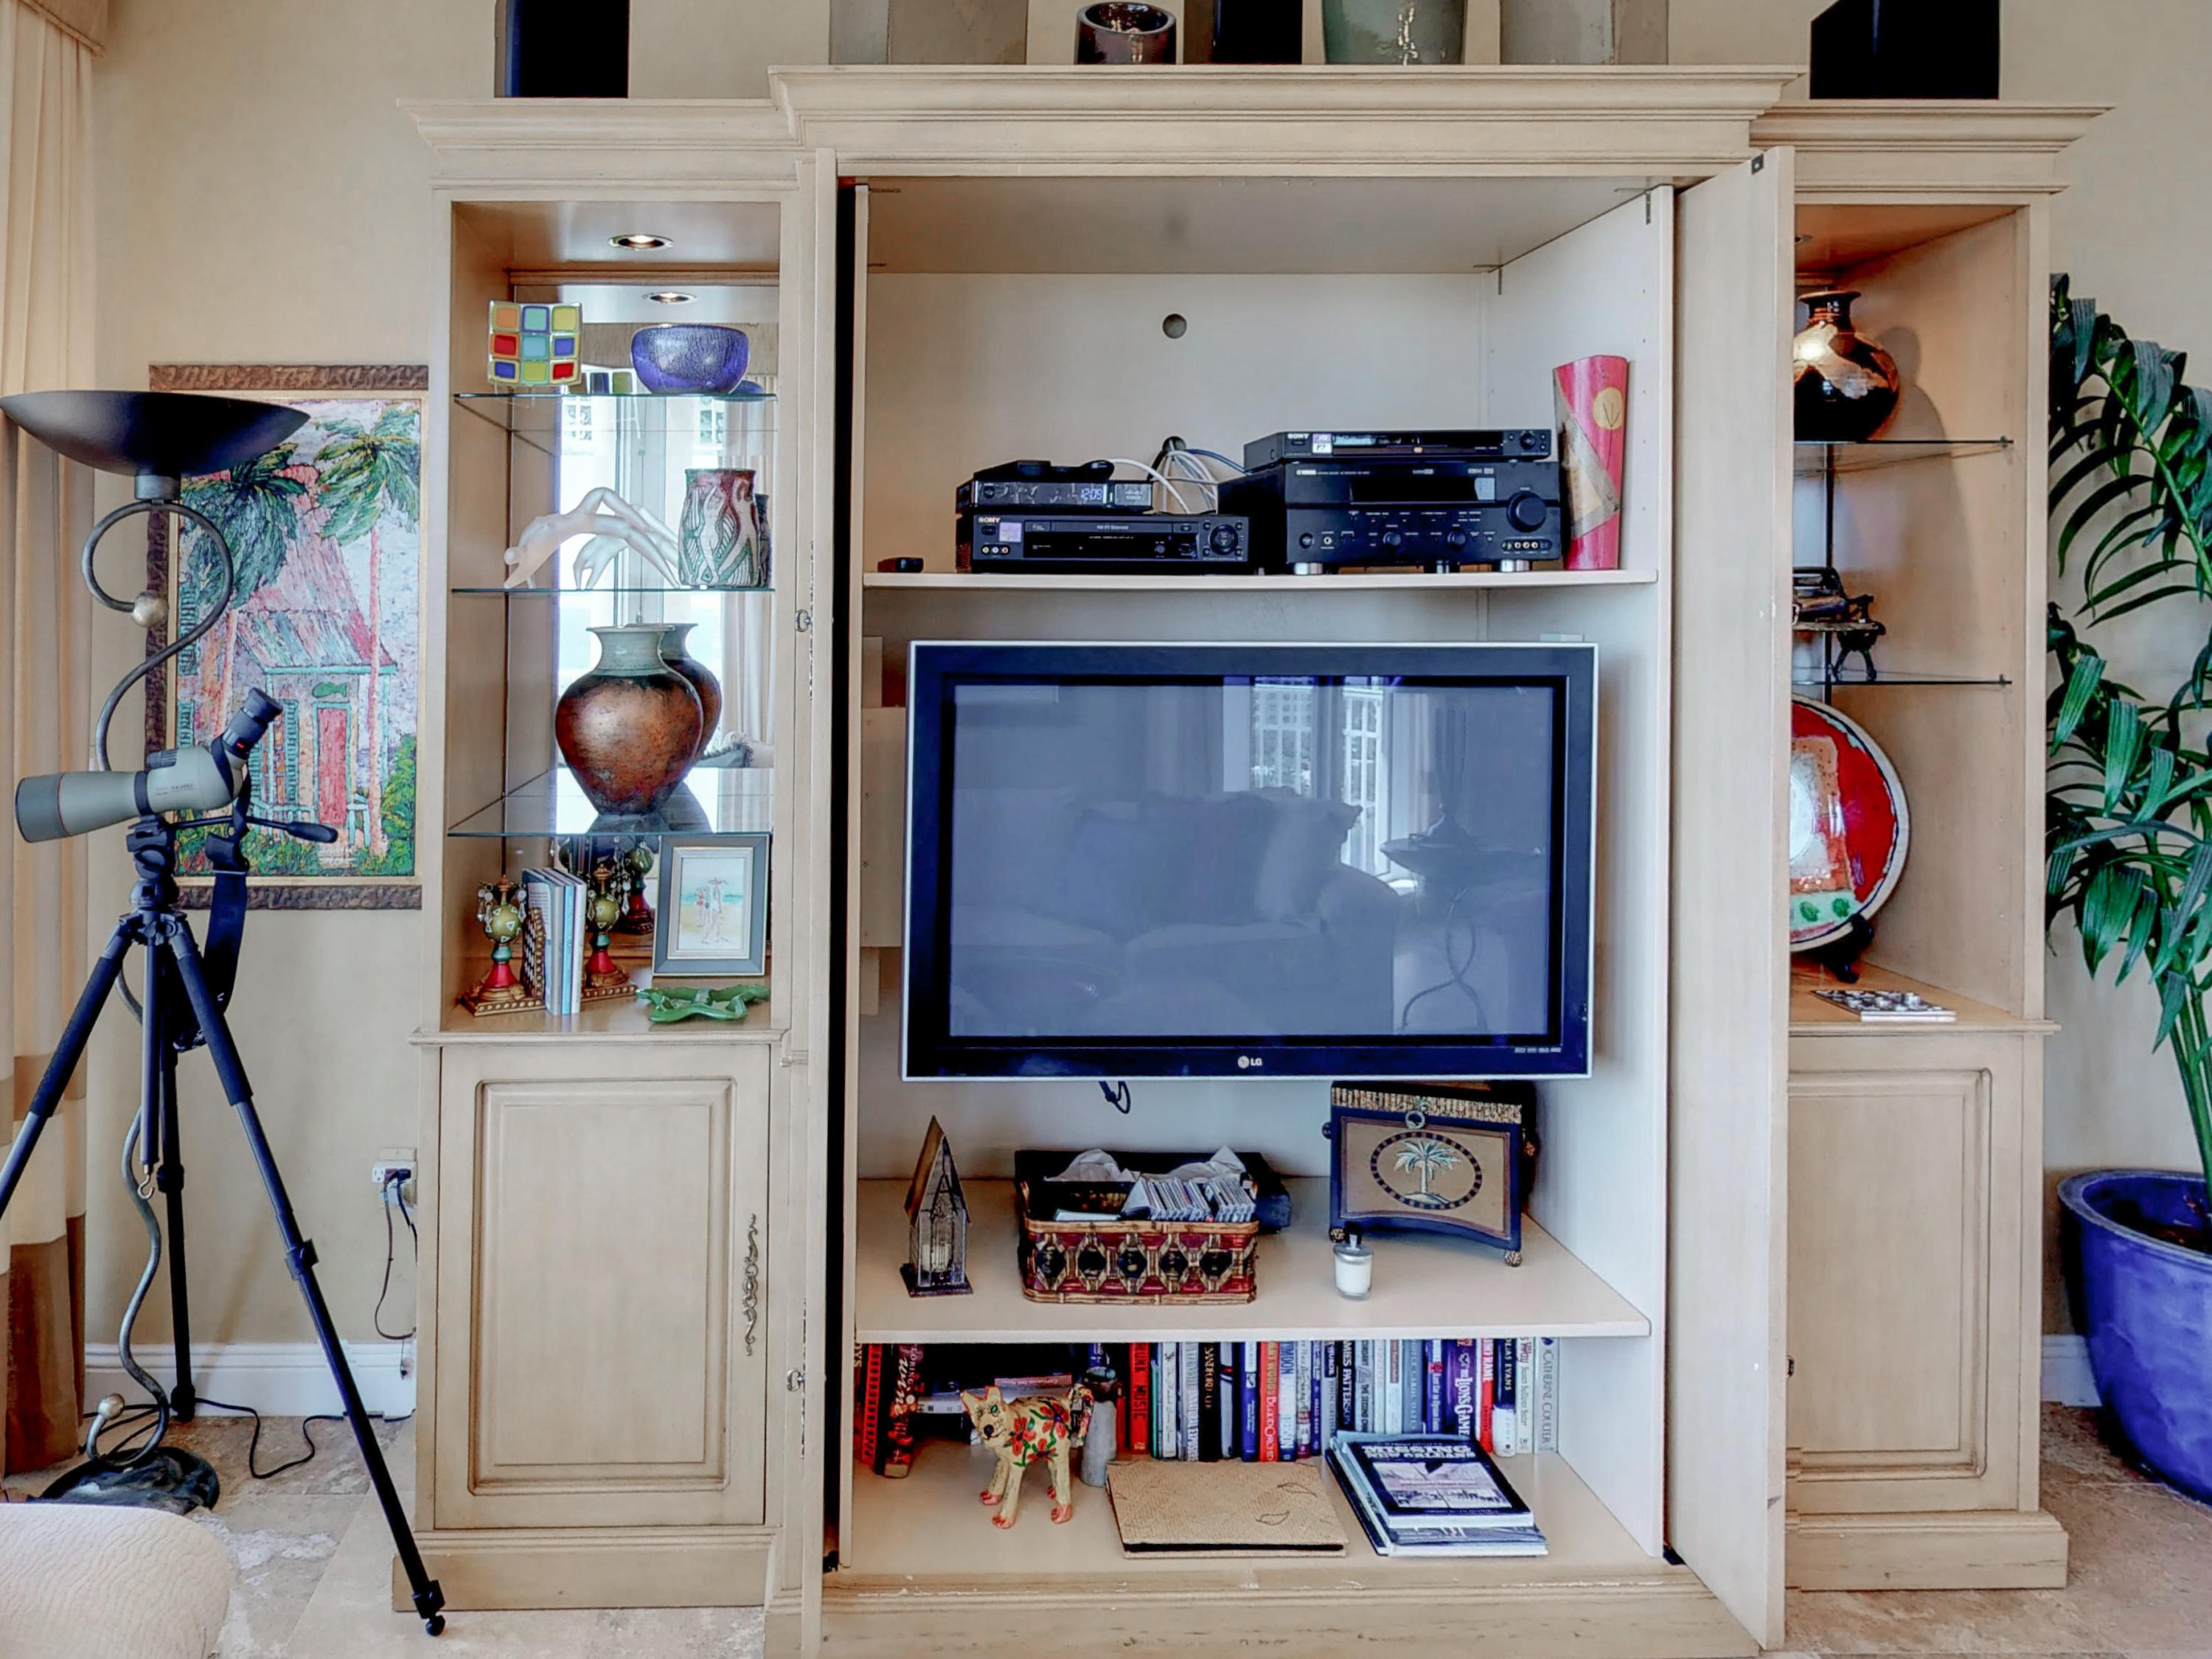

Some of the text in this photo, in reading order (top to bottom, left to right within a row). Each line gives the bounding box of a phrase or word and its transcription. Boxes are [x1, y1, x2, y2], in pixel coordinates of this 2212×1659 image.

[1250, 1057, 1263, 1066] LG
[1134, 1343, 1147, 1419] RUNK MUSIC
[1342, 1340, 1353, 1425] AMES PATTERSON
[1504, 1363, 1512, 1391] EVANS
[1453, 1405, 1473, 1436] GAME
[1542, 1402, 1553, 1444] COULTER
